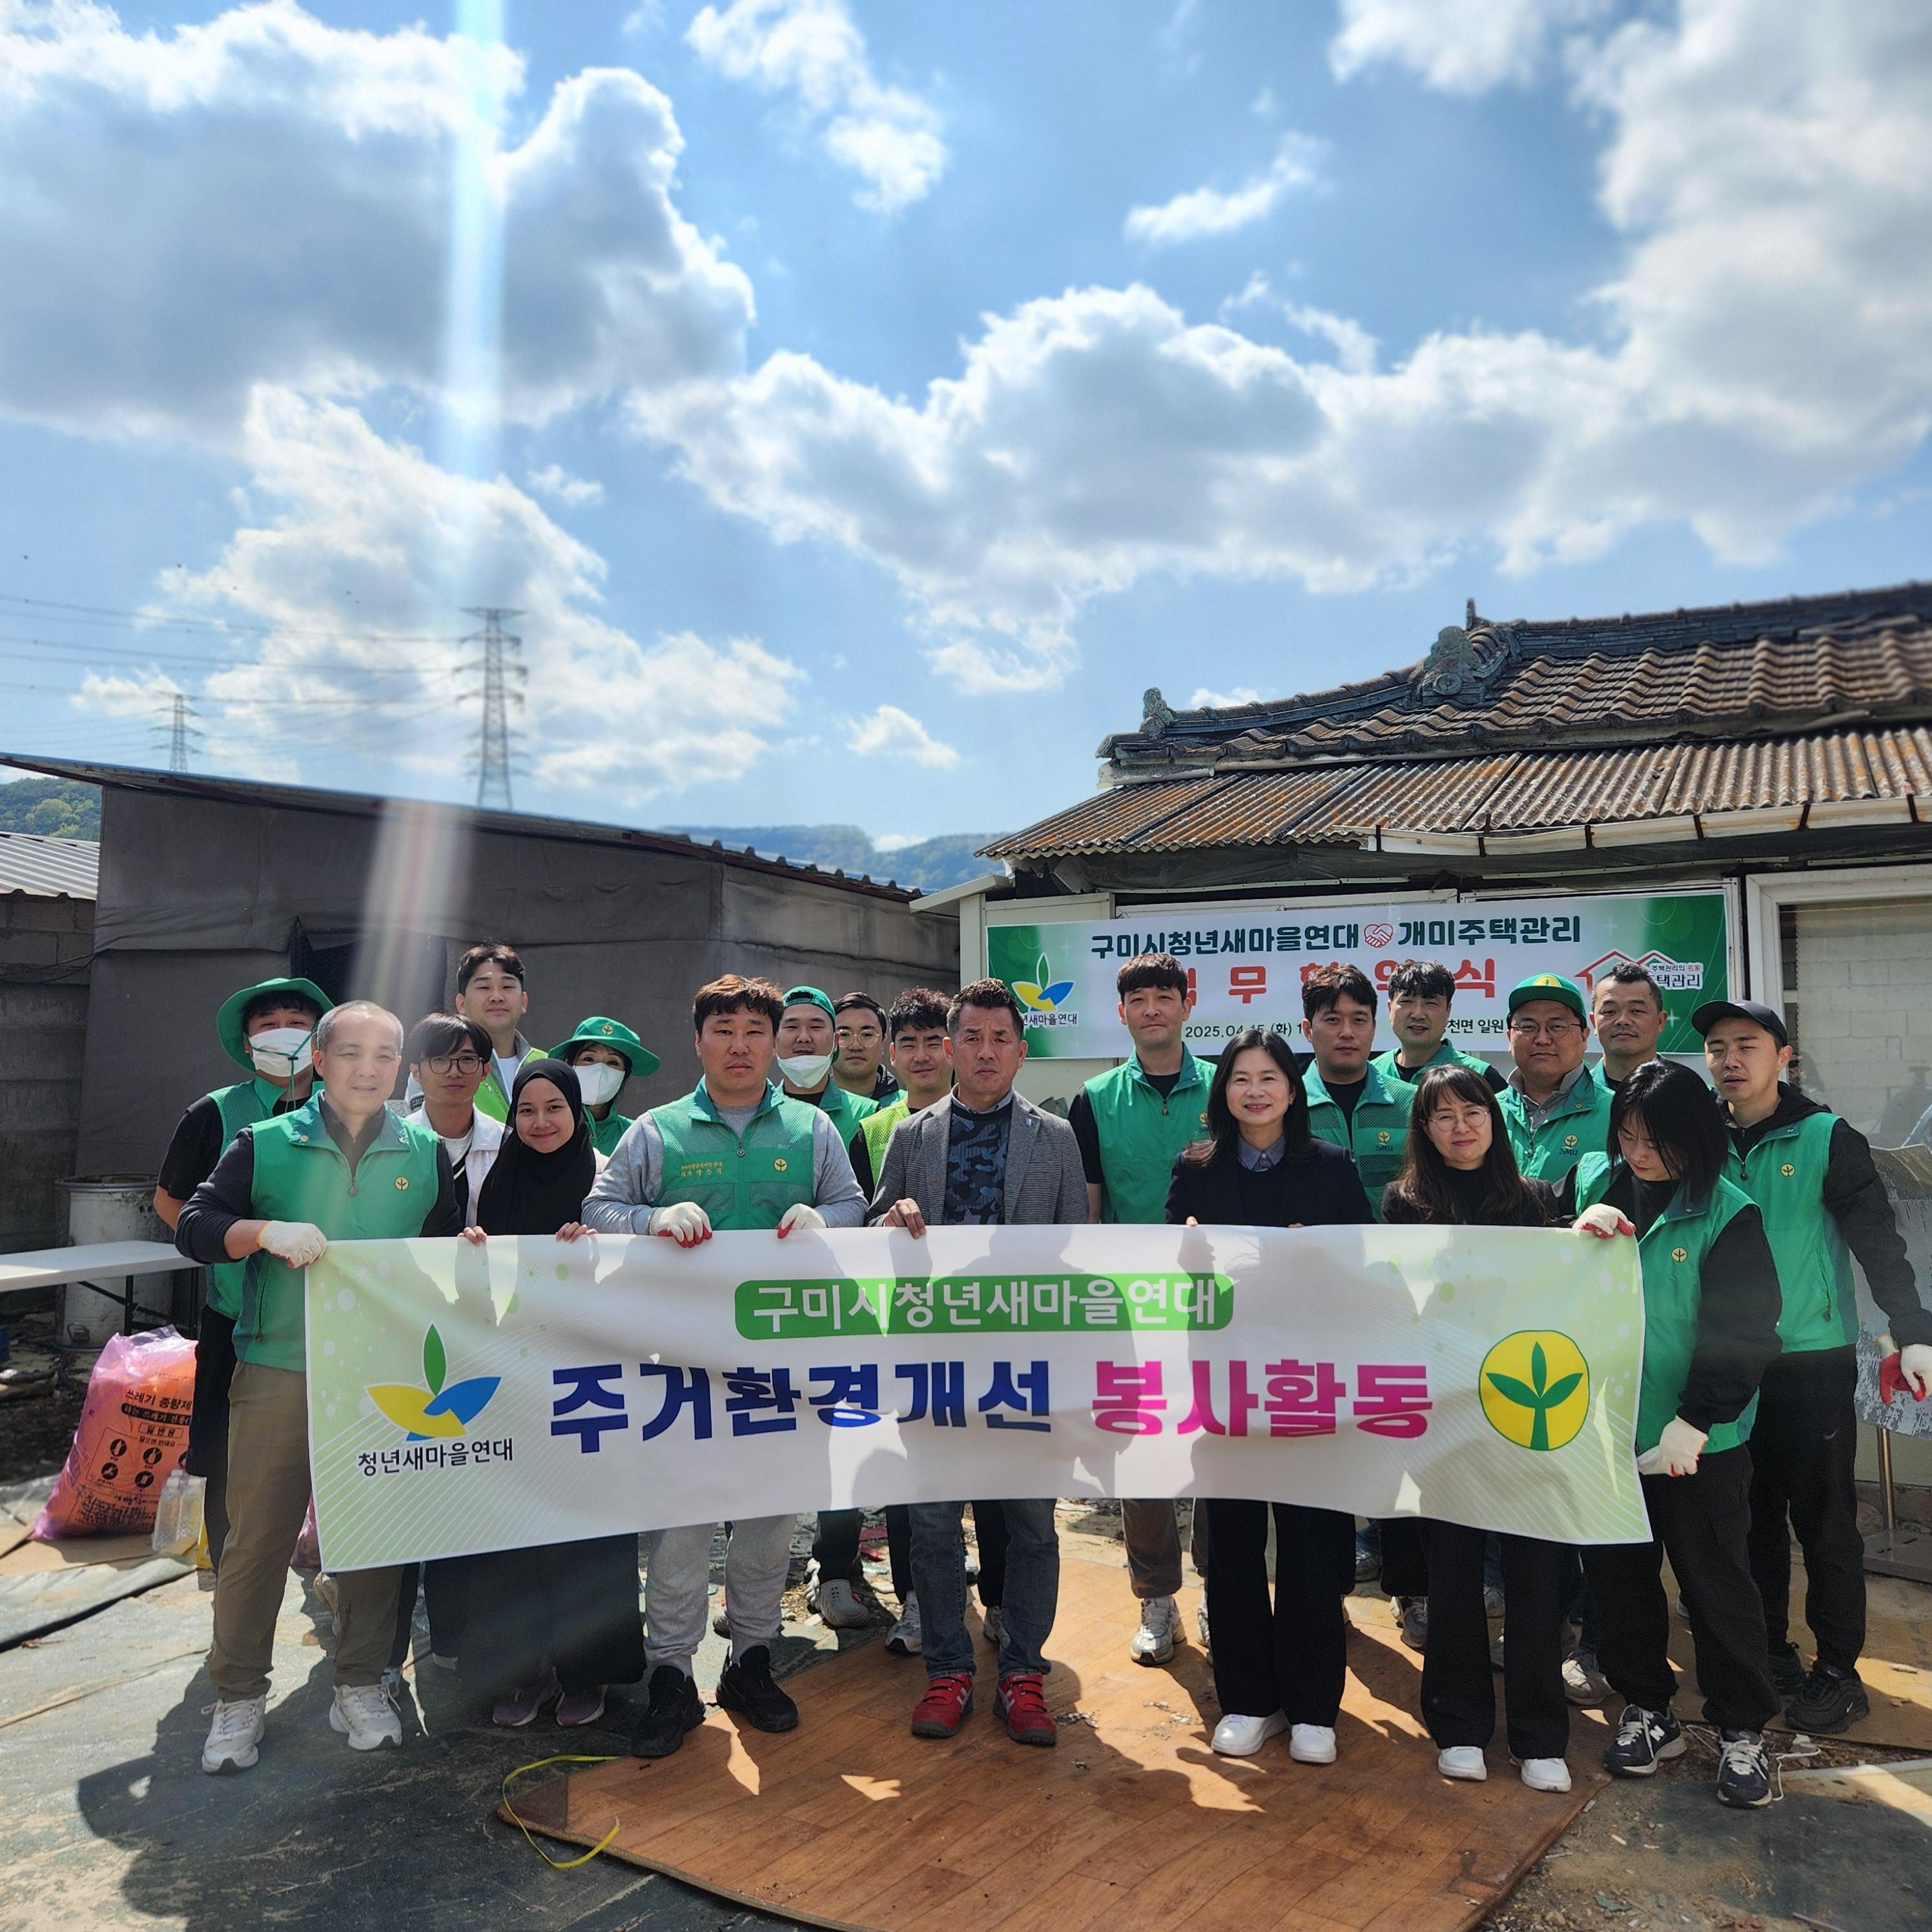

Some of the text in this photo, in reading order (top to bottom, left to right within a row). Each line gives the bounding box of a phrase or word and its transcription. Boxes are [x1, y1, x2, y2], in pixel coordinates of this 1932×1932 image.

[1091, 916, 1580, 959] 구미시청년새마을연대 개미주택관리
[1477, 1019, 1504, 1034] 일원
[753, 1279, 1216, 1332] 구미시청년새마을연대
[125, 1389, 156, 1406] 쓰레기
[551, 1359, 1434, 1454] 주거환경개선 봉사활동
[358, 1437, 513, 1477] 청년새마을연대
